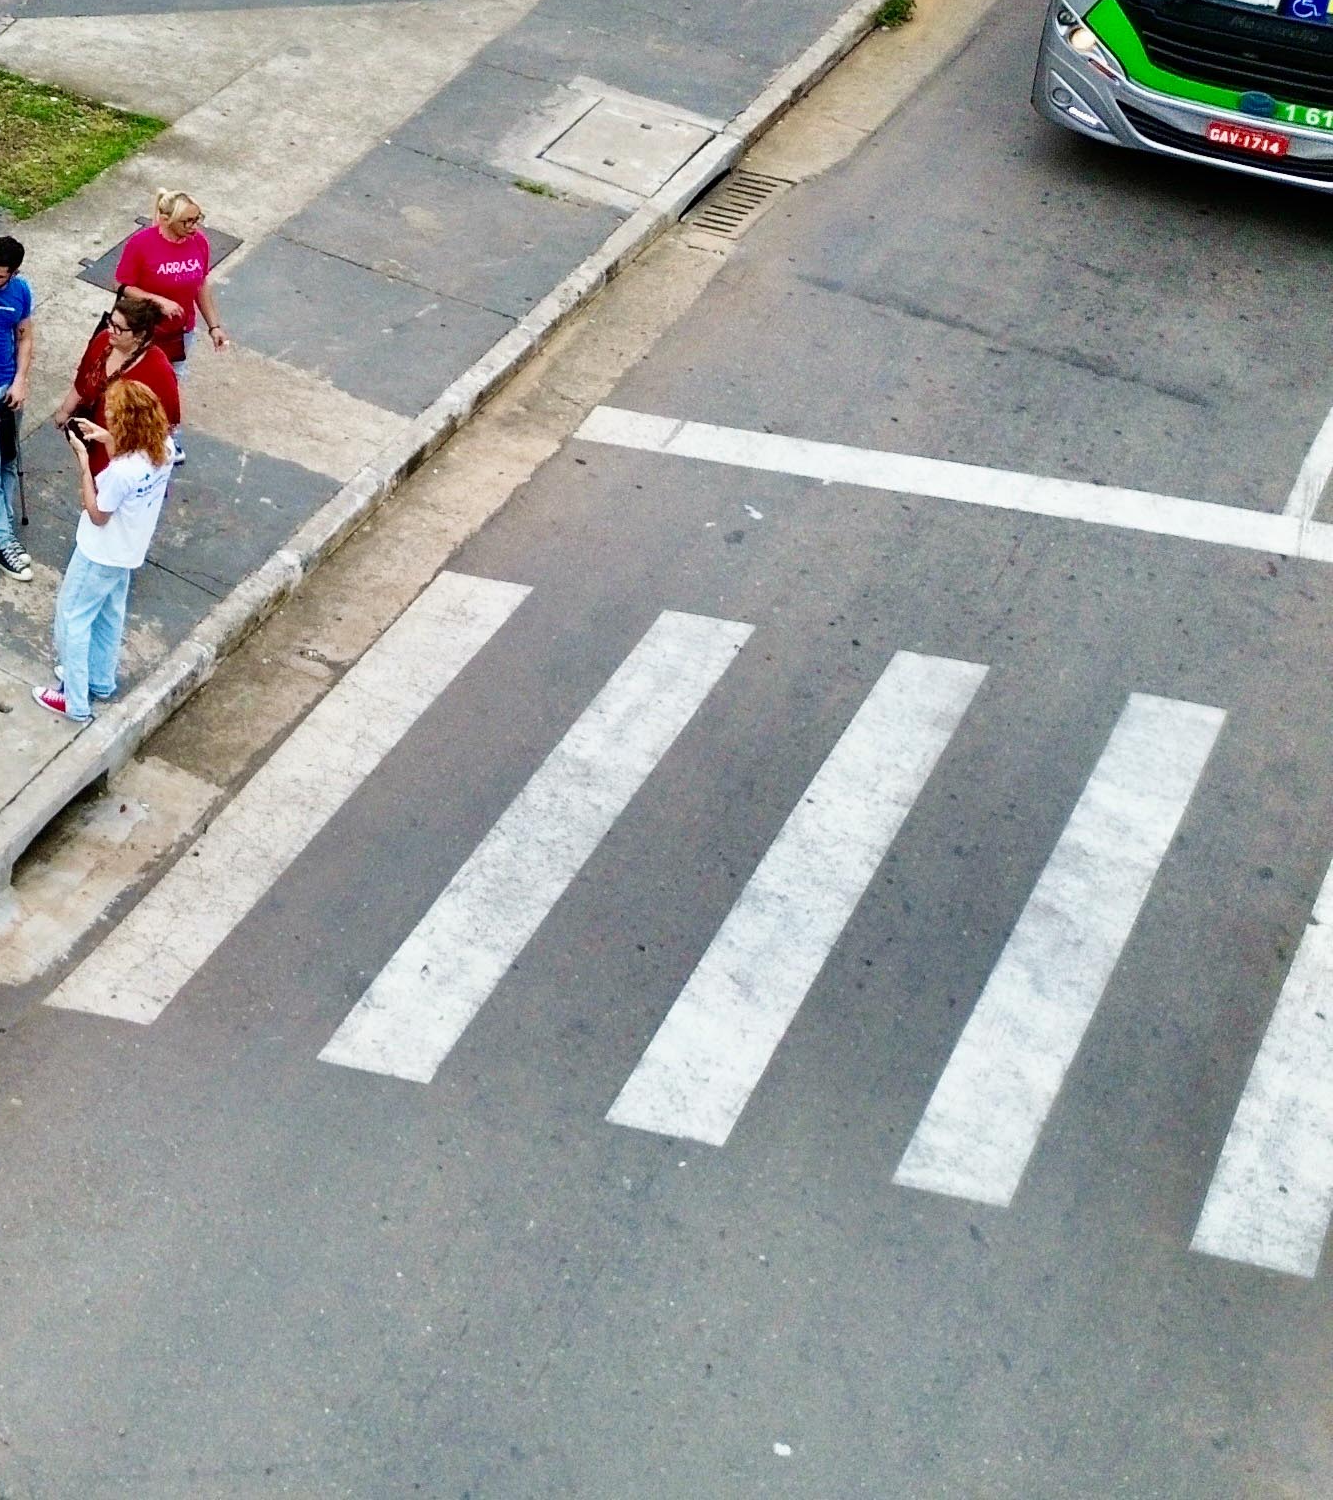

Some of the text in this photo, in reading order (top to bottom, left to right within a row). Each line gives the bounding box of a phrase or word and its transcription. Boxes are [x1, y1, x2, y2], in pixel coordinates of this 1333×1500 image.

[1285, 104, 1296, 121] 1
[1210, 128, 1280, 154] GAV-1714
[156, 259, 201, 275] ARRASA
